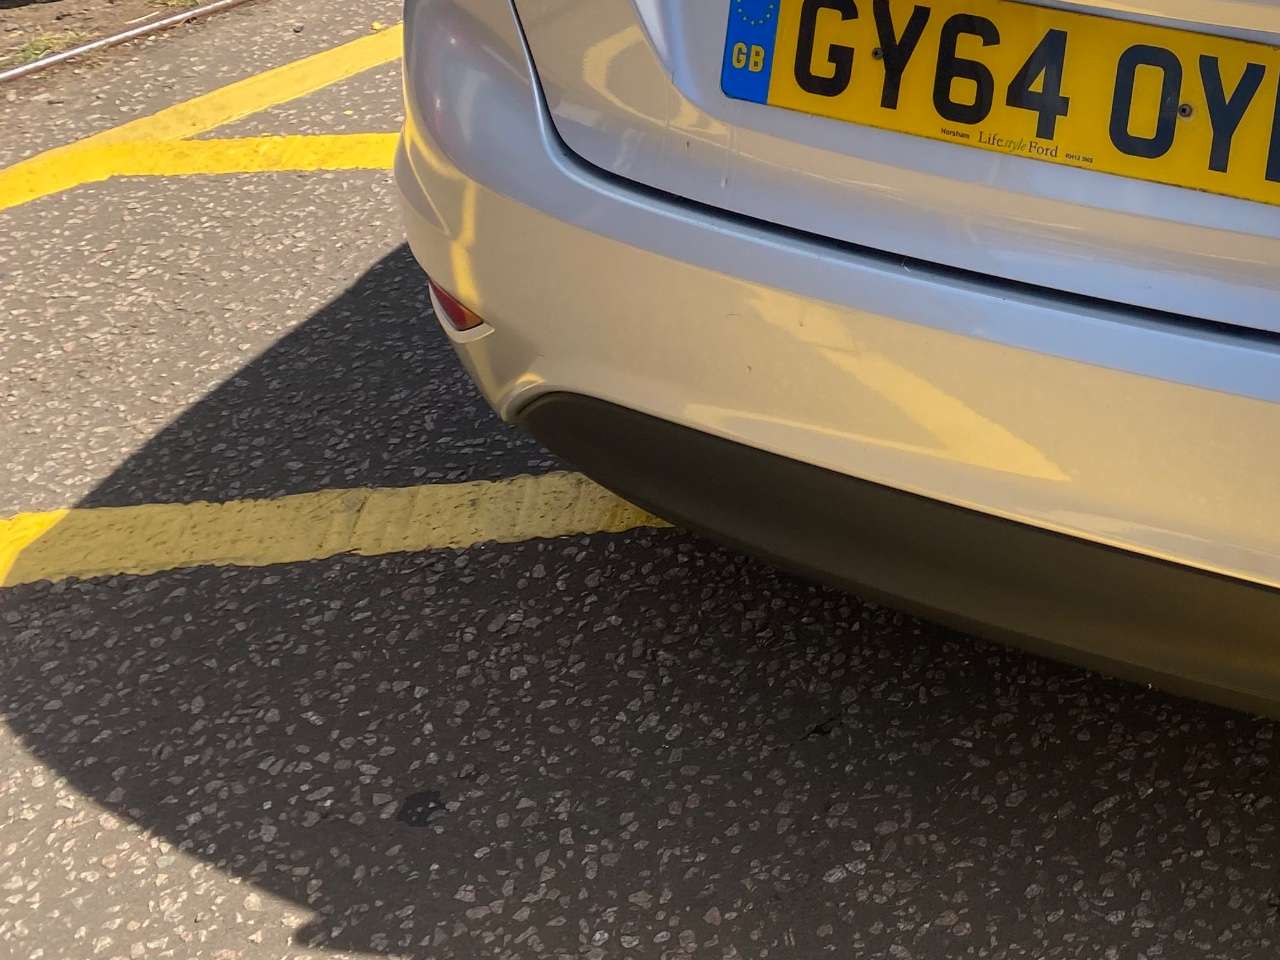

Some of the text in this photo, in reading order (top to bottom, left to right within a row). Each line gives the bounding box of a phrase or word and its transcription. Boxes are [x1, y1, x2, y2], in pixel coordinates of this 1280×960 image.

[732, 42, 766, 73] GB
[940, 127, 970, 139] Horsham
[1028, 141, 1059, 158] Ford
